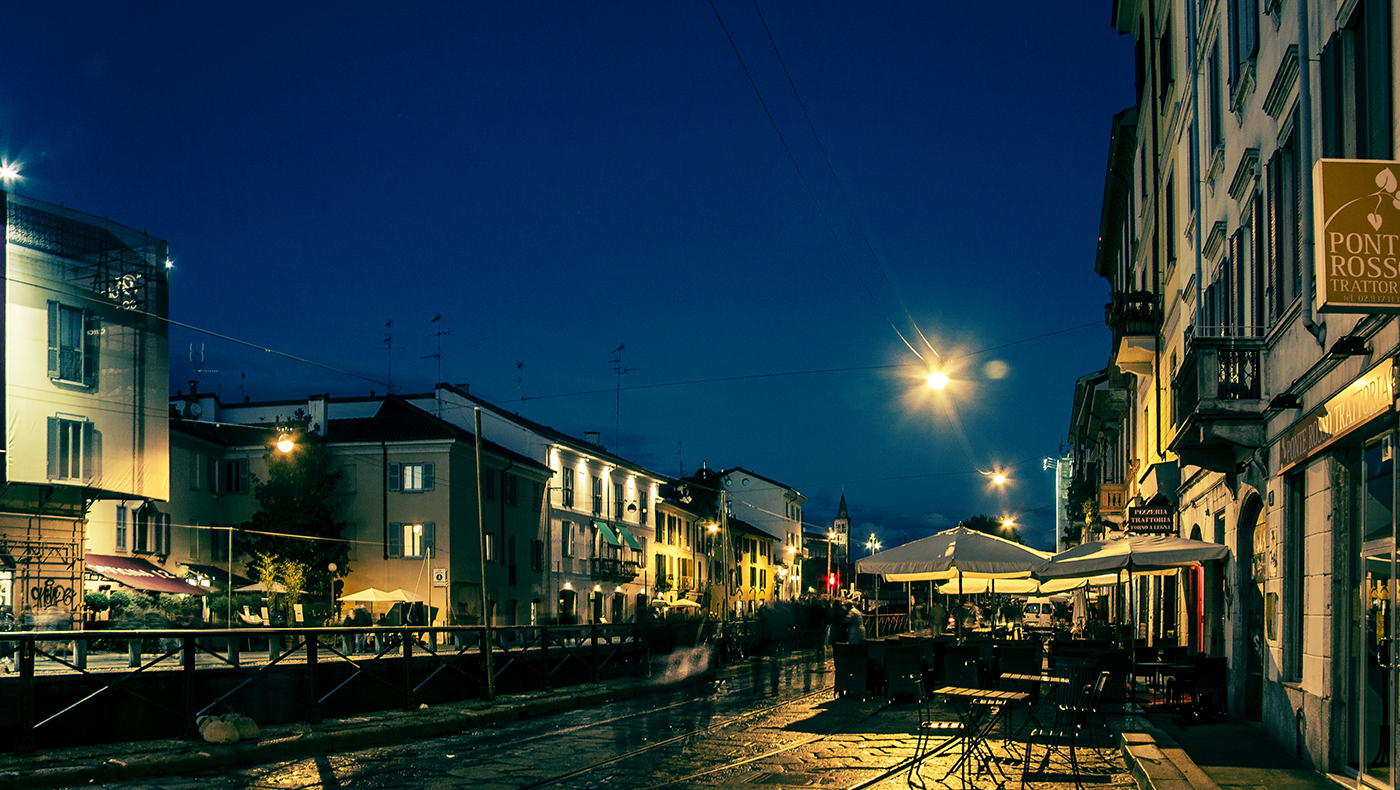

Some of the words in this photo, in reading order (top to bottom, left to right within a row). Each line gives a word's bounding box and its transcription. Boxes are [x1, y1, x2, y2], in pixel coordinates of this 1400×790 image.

[1328, 231, 1400, 256] PONT
[1330, 255, 1400, 279] ROSS
[1333, 372, 1391, 434] TRATTORIA
